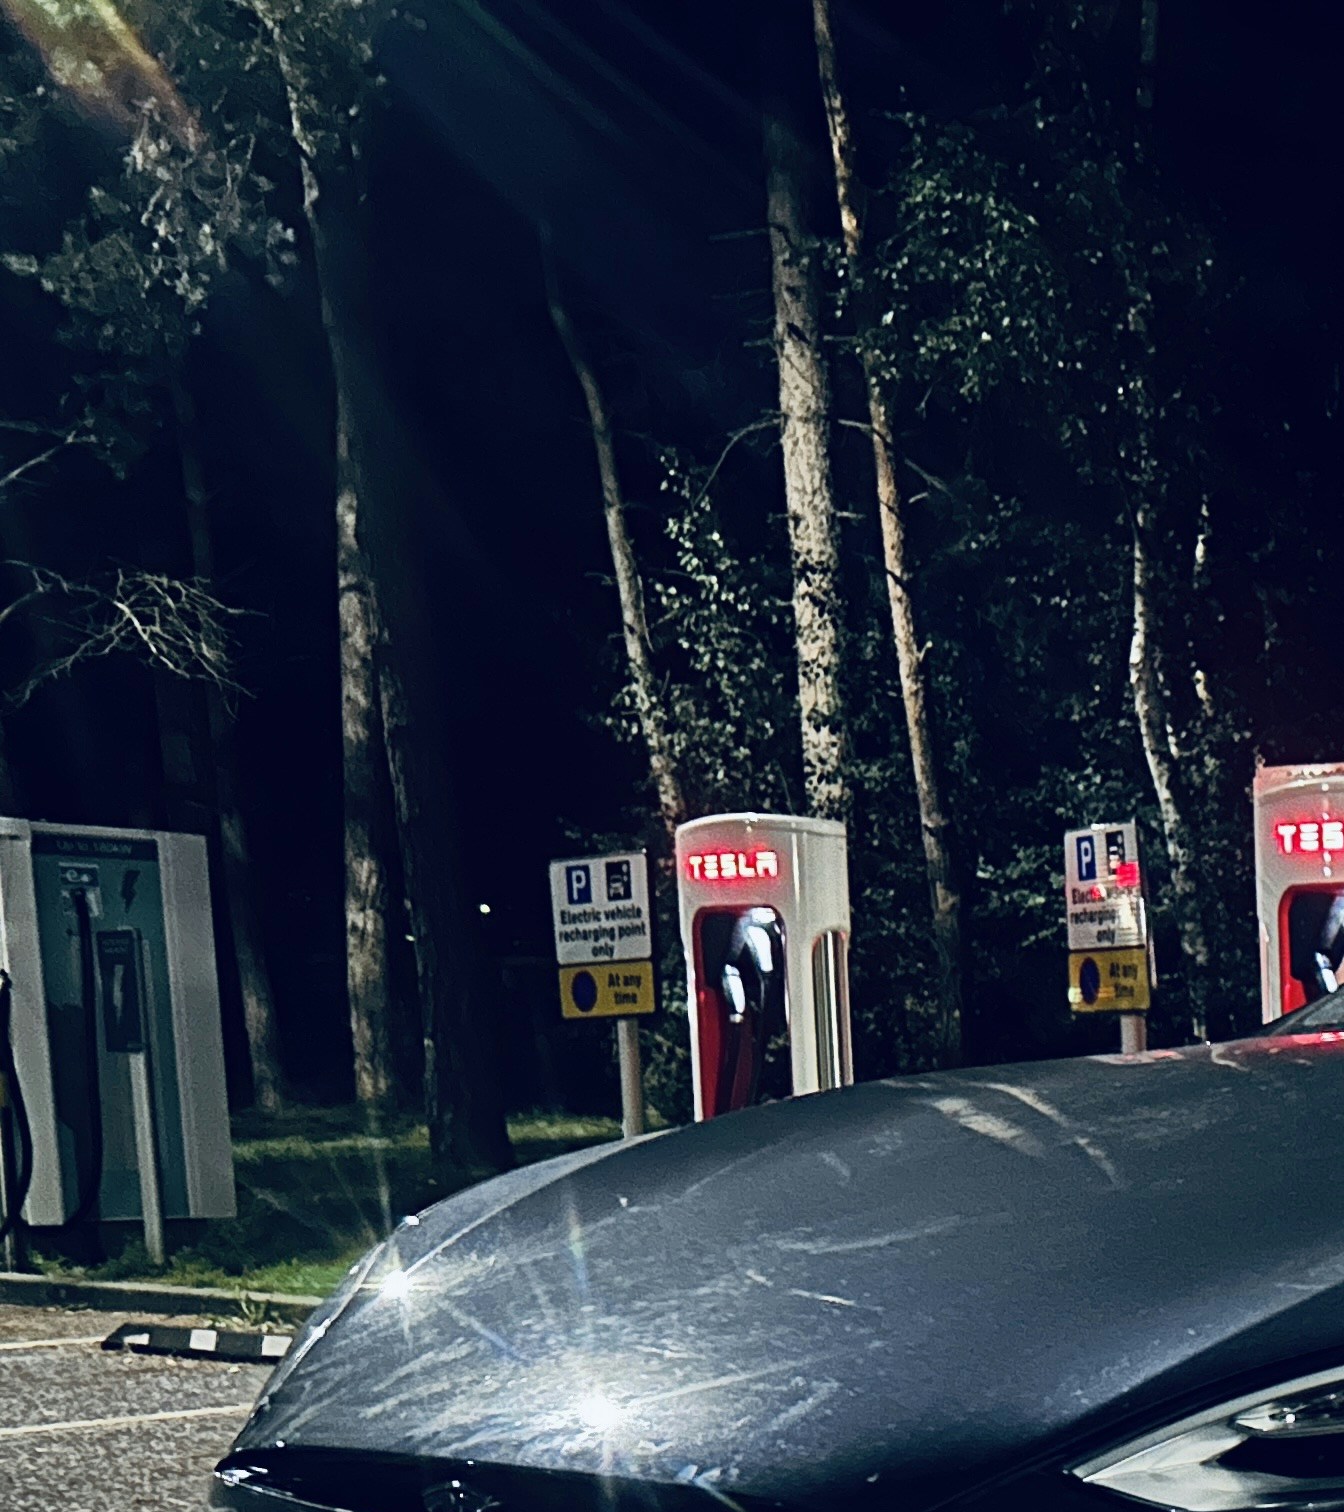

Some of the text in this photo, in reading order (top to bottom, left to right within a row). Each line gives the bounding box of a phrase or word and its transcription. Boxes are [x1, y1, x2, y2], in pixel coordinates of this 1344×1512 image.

[688, 850, 778, 880] TESLA
[1080, 840, 1092, 878] P
[571, 870, 587, 901] P
[560, 904, 642, 925] Electric vehicle
[559, 921, 646, 943] recharging point
[591, 942, 615, 958] only
[607, 973, 642, 989] At any
